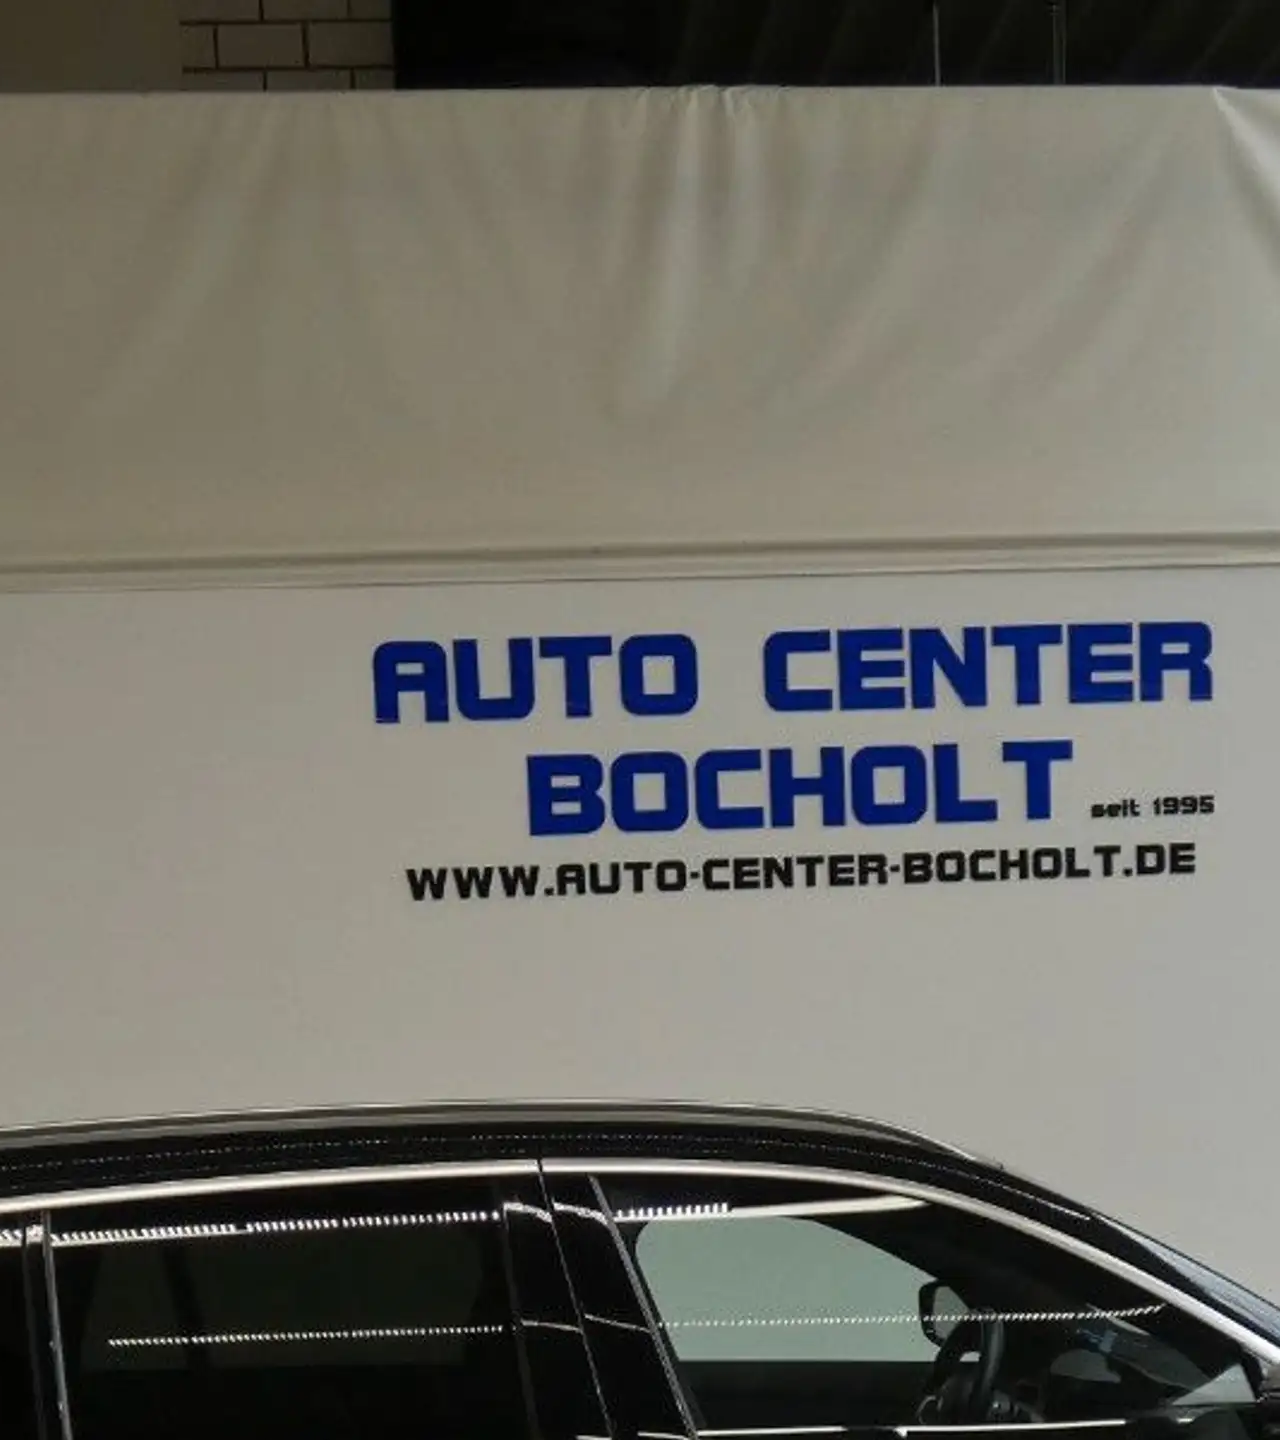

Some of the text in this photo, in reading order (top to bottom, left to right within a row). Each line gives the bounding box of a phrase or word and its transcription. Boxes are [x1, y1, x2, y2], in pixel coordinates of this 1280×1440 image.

[373, 621, 1214, 724] AUTO CENTER
[526, 739, 1074, 837] BOCHOLT
[1091, 795, 1216, 819] seit 1995
[405, 841, 1197, 902] WWW.AUTO-CENTER-BOCHOLT.DE
